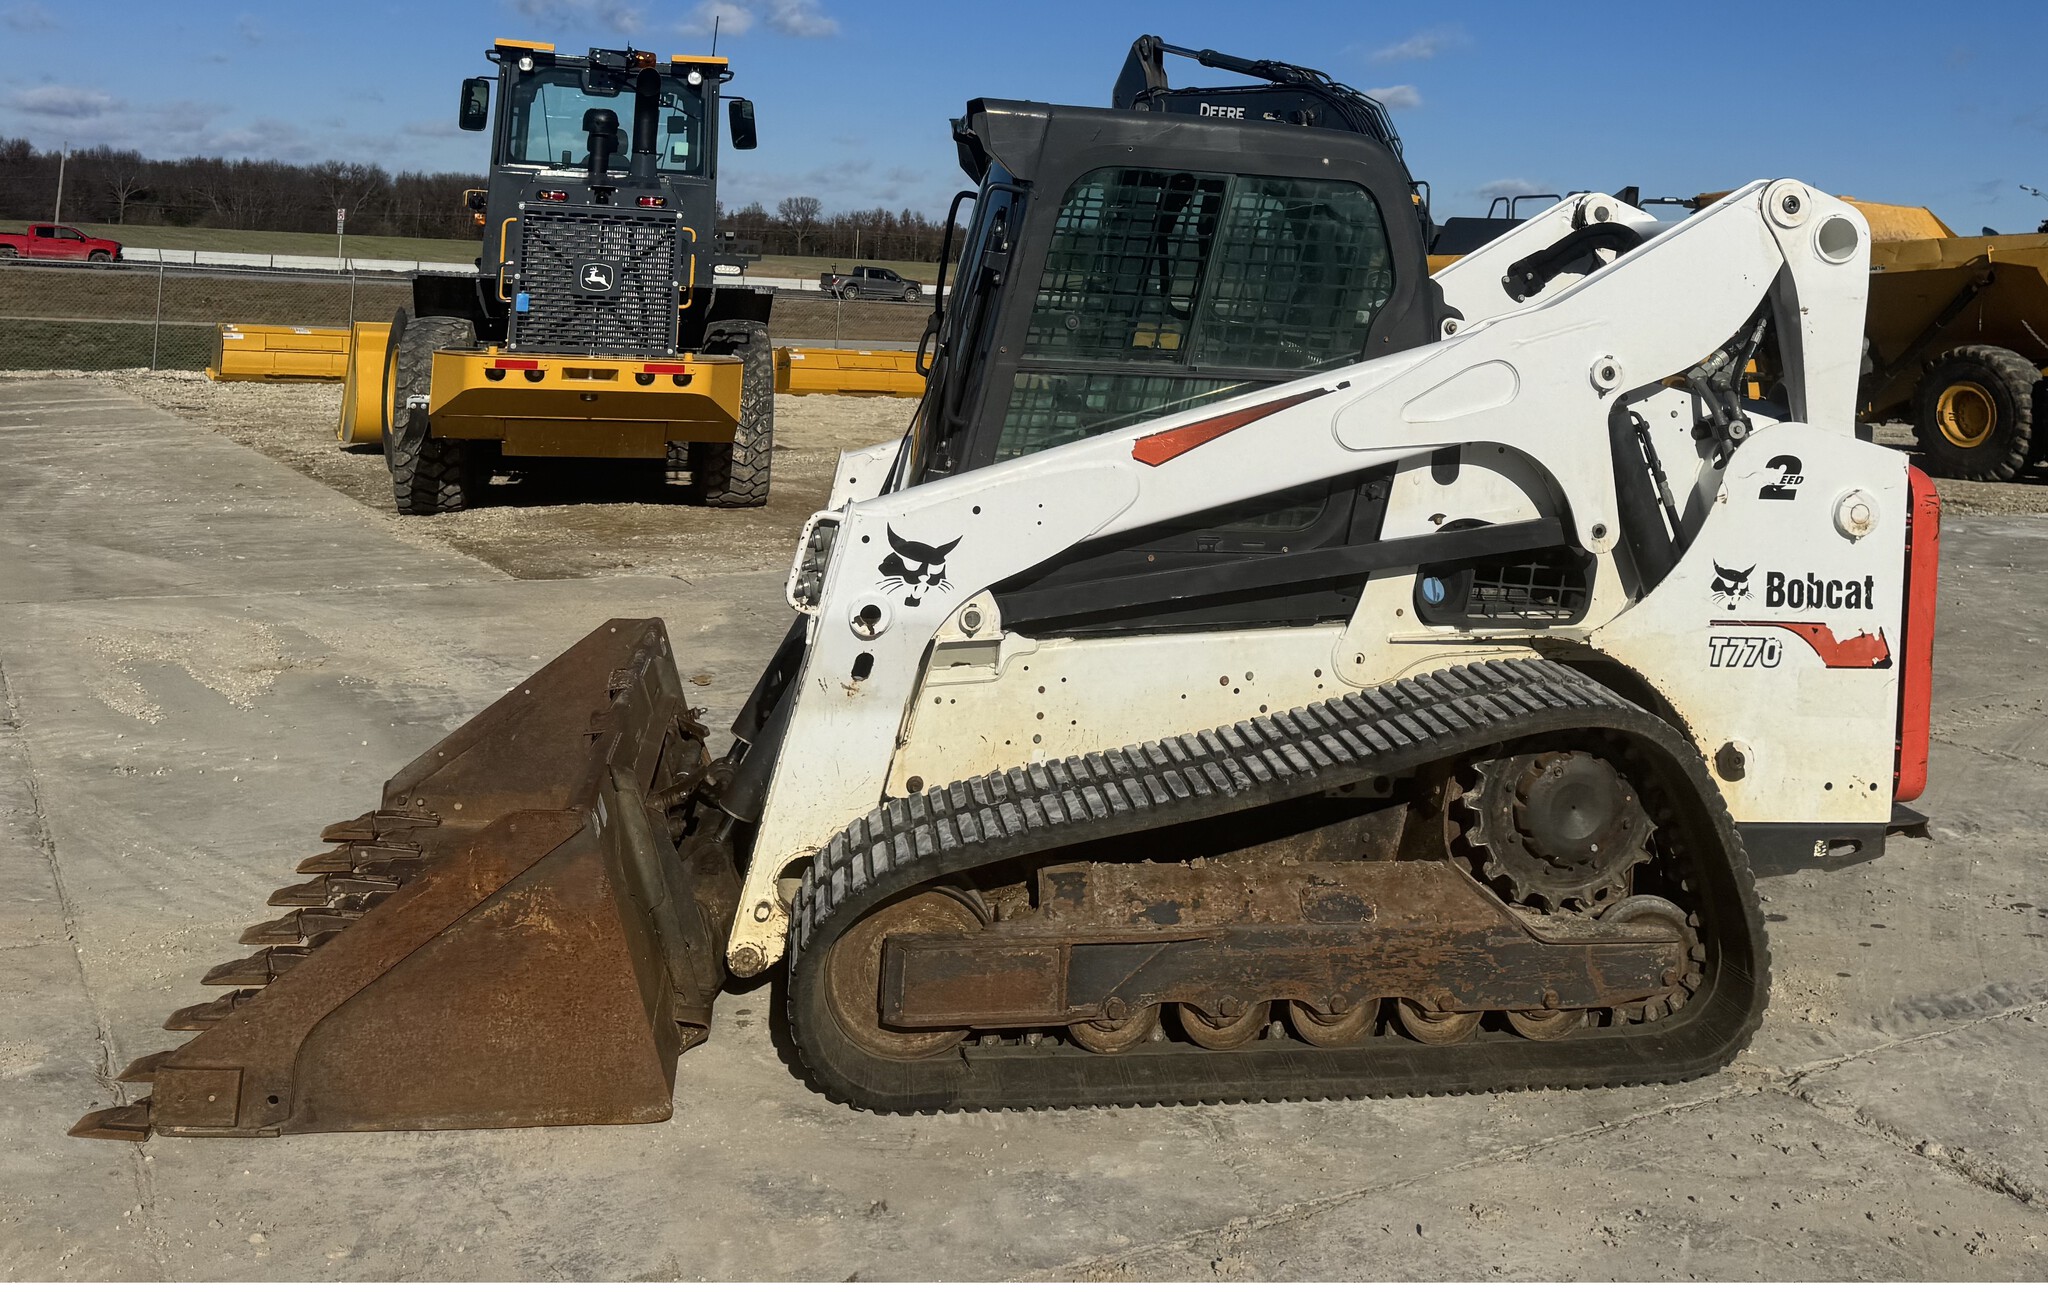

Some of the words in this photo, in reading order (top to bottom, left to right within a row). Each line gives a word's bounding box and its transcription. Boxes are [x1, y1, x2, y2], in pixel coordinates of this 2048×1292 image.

[1200, 102, 1245, 120] DEERE
[1758, 454, 1803, 501] 2
[1765, 571, 1874, 610] Bobcat
[1708, 636, 1783, 668] T770
